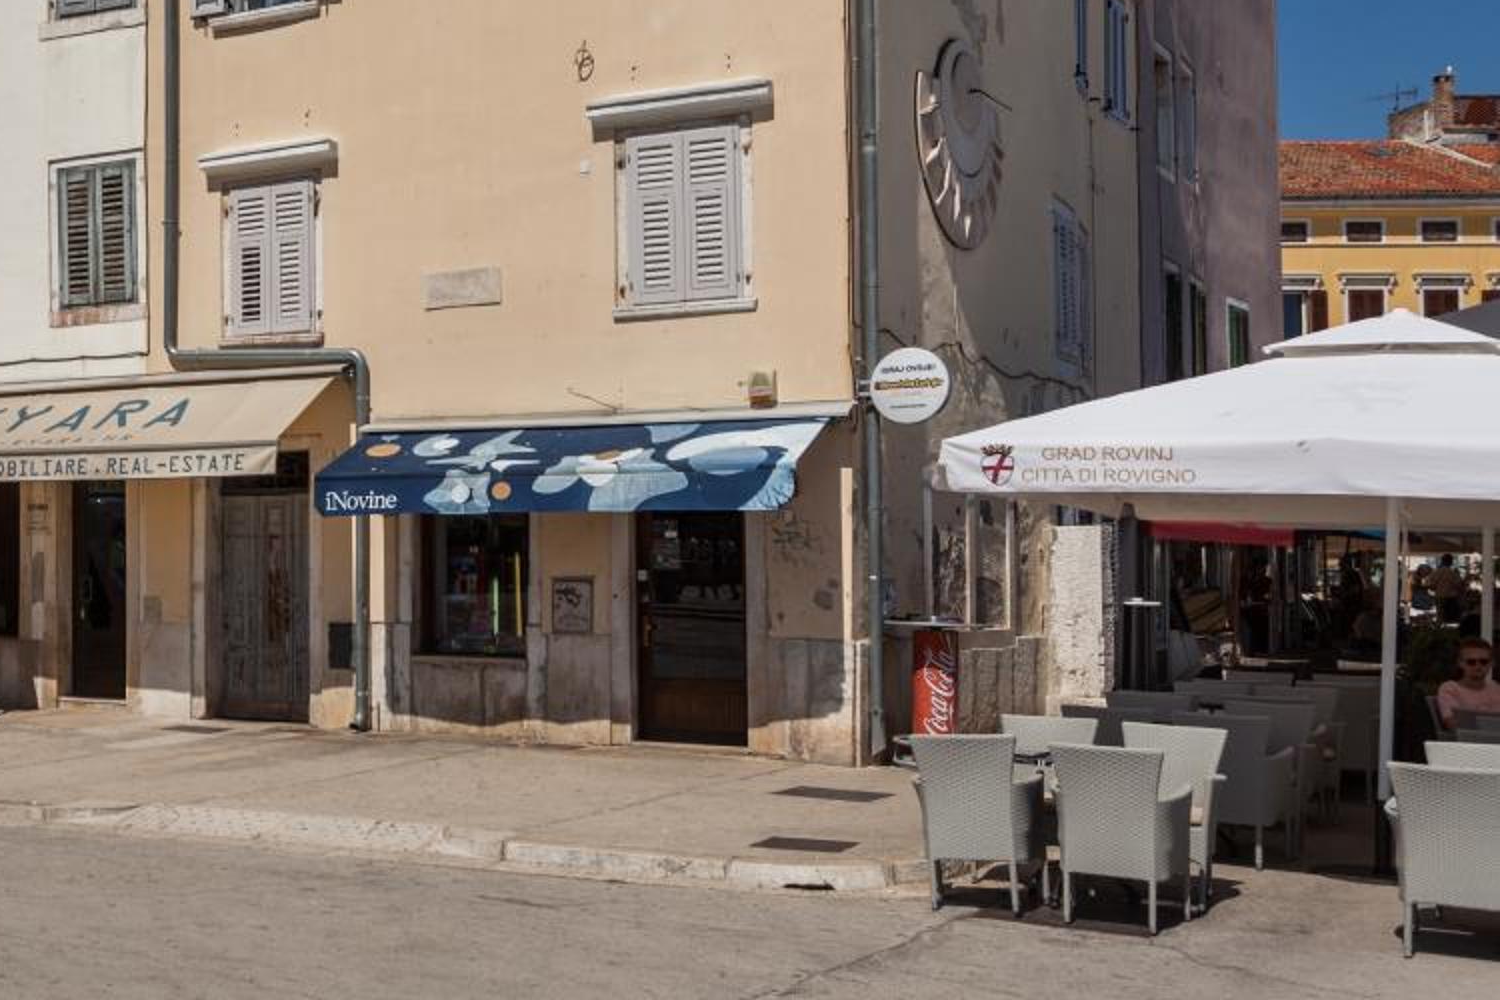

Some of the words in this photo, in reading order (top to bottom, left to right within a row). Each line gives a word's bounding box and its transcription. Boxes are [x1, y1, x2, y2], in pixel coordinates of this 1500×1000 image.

[1041, 447, 1095, 461] GRAD
[1101, 447, 1173, 461] ROVINJ
[1021, 465, 1075, 483] CITTÀ
[1079, 469, 1097, 482] DI
[1103, 468, 1197, 483] ROVIGNO
